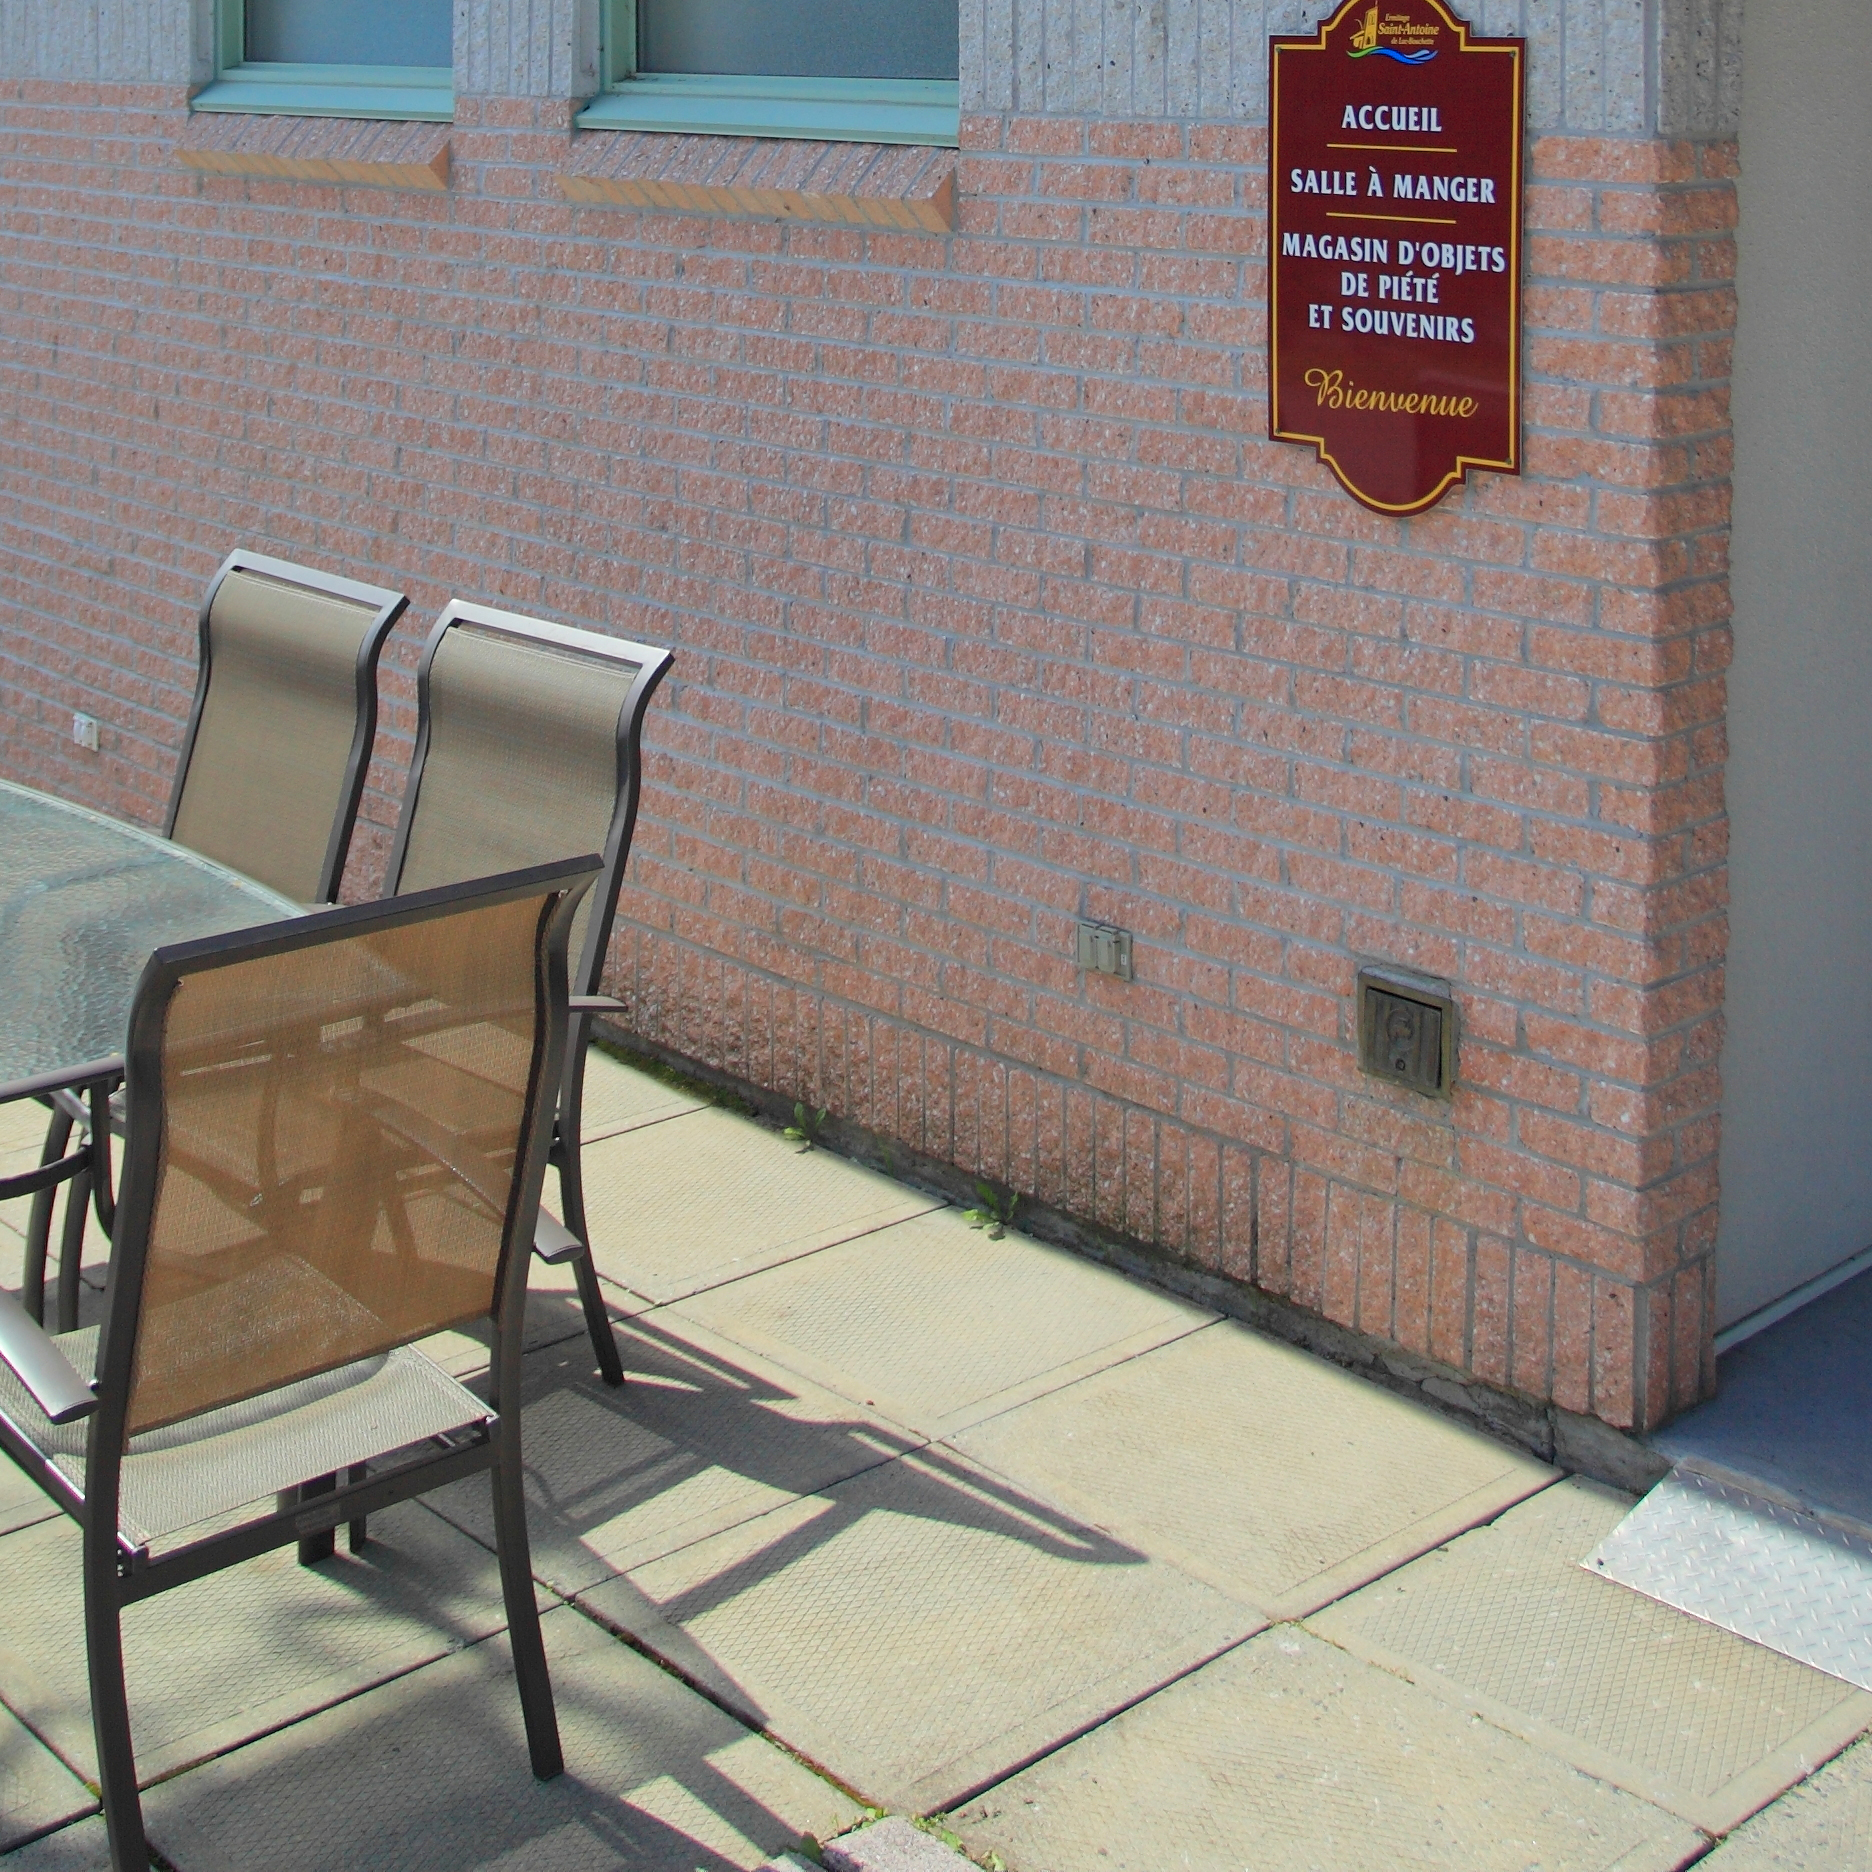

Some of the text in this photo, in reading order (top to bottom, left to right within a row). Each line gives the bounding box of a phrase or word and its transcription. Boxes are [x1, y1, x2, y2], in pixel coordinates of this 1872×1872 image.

[1378, 22, 1440, 35] Saint-Antoine
[1341, 104, 1442, 132] ACCUEIL
[1290, 166, 1496, 204] SALLE À MANGER
[1281, 232, 1506, 275] MAGASIN D'OBJETS
[1340, 270, 1440, 304] DE PIÉTÉ
[1308, 304, 1475, 343] ET SOUVENIRS
[1304, 367, 1479, 418] Bienvenue
